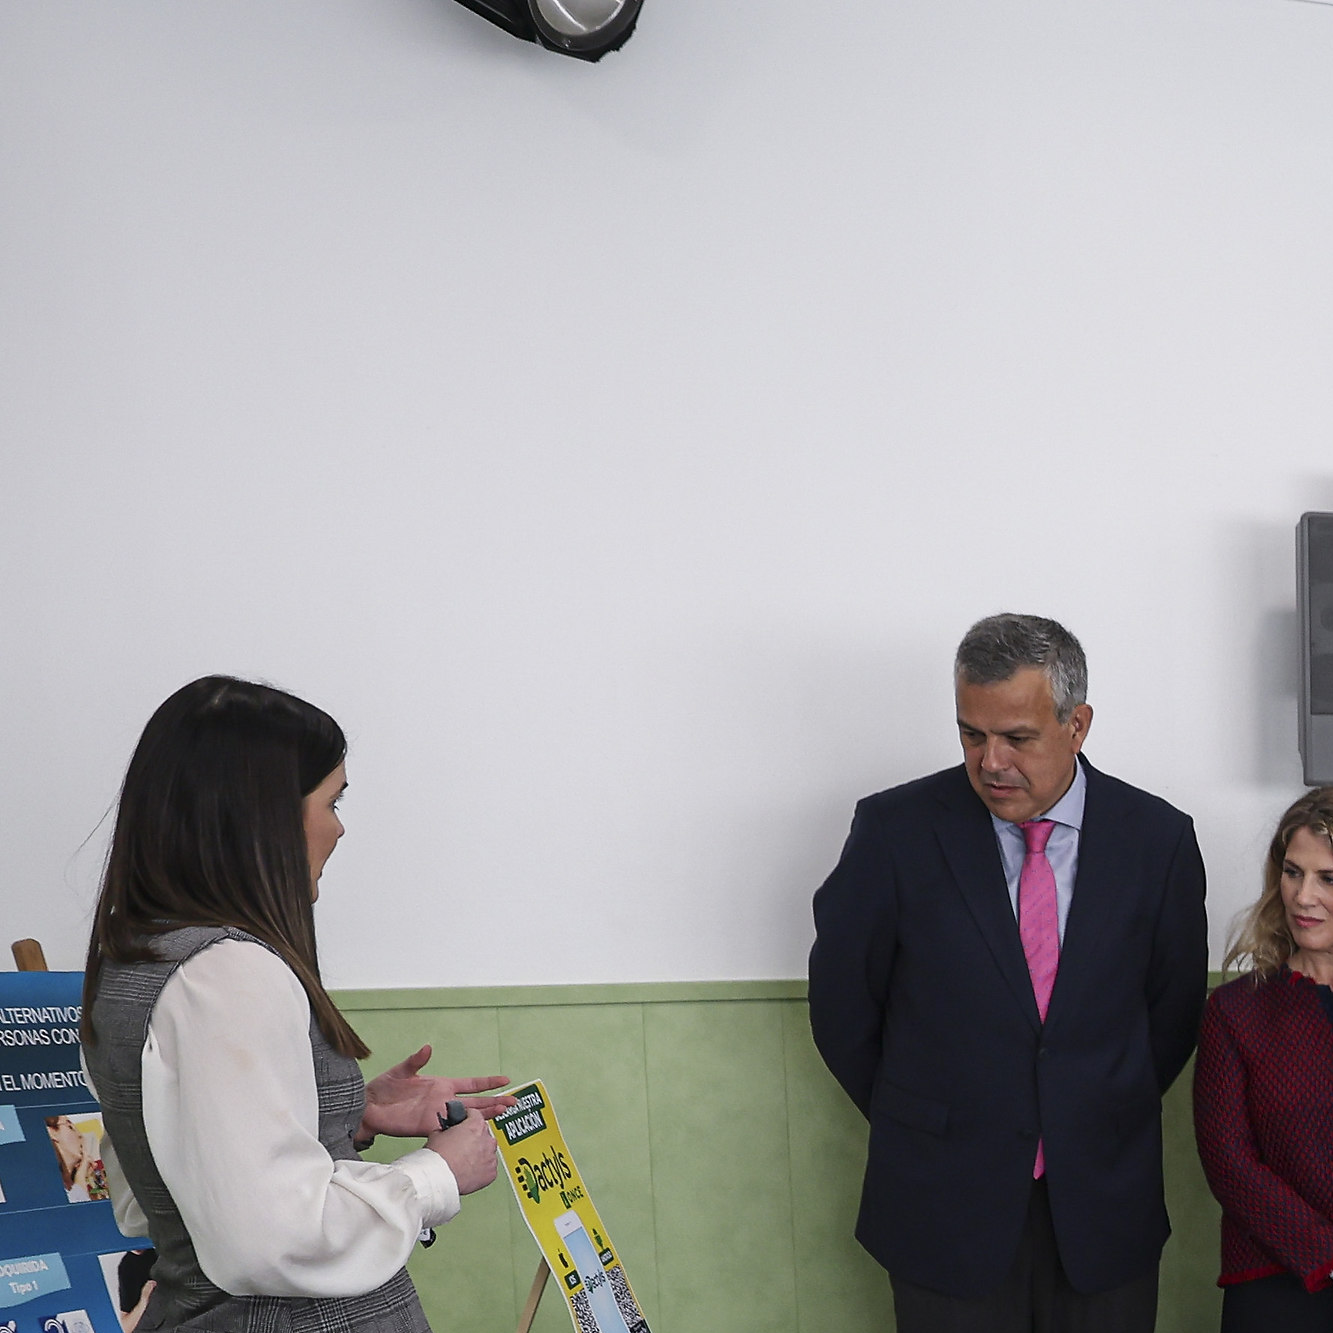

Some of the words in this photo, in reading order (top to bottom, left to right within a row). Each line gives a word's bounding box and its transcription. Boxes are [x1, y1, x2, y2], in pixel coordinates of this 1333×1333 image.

[51, 1028, 81, 1044] CON
[2, 1074, 21, 1091] EL
[20, 1071, 87, 1090] MOMENTO
[504, 1108, 544, 1141] APLICACIÓN
[515, 1145, 572, 1204] Dactyls
[566, 1184, 584, 1203] ONCE
[8, 1281, 33, 1296] Tipo
